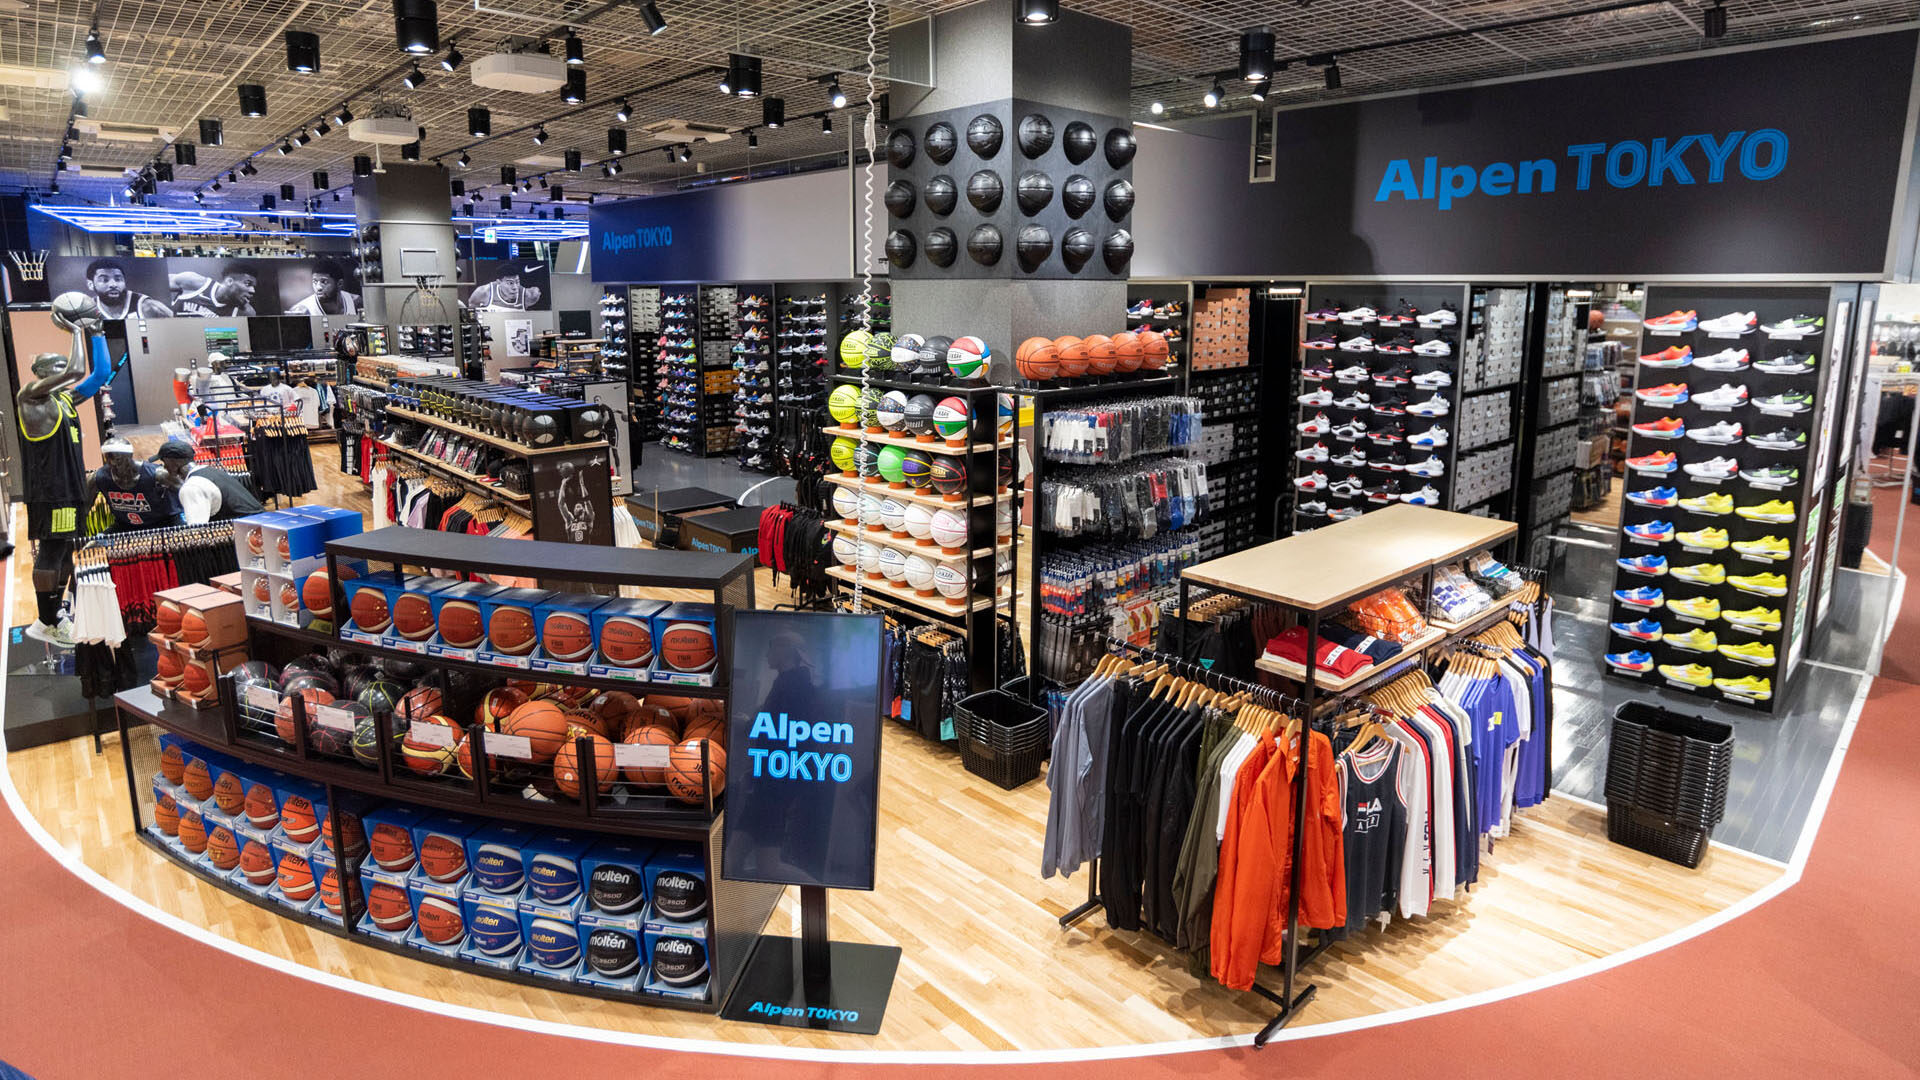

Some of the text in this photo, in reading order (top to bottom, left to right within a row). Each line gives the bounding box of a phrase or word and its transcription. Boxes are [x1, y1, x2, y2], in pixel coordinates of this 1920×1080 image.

[1374, 128, 1789, 210] Alpen TOKYO
[602, 226, 673, 254] Alpen TOKYO
[127, 512, 144, 525] 9
[741, 546, 760, 555] Alp
[749, 712, 854, 748] Alpen
[748, 748, 853, 783] TOKYO
[478, 856, 504, 867] molten
[531, 865, 557, 878] molten
[592, 870, 631, 884] molten
[656, 876, 696, 890] molten
[475, 915, 499, 926] molten
[531, 932, 556, 944] molten
[590, 935, 627, 949] molten
[656, 941, 694, 955] molten
[748, 1001, 859, 1022] Alpen TOKYO
